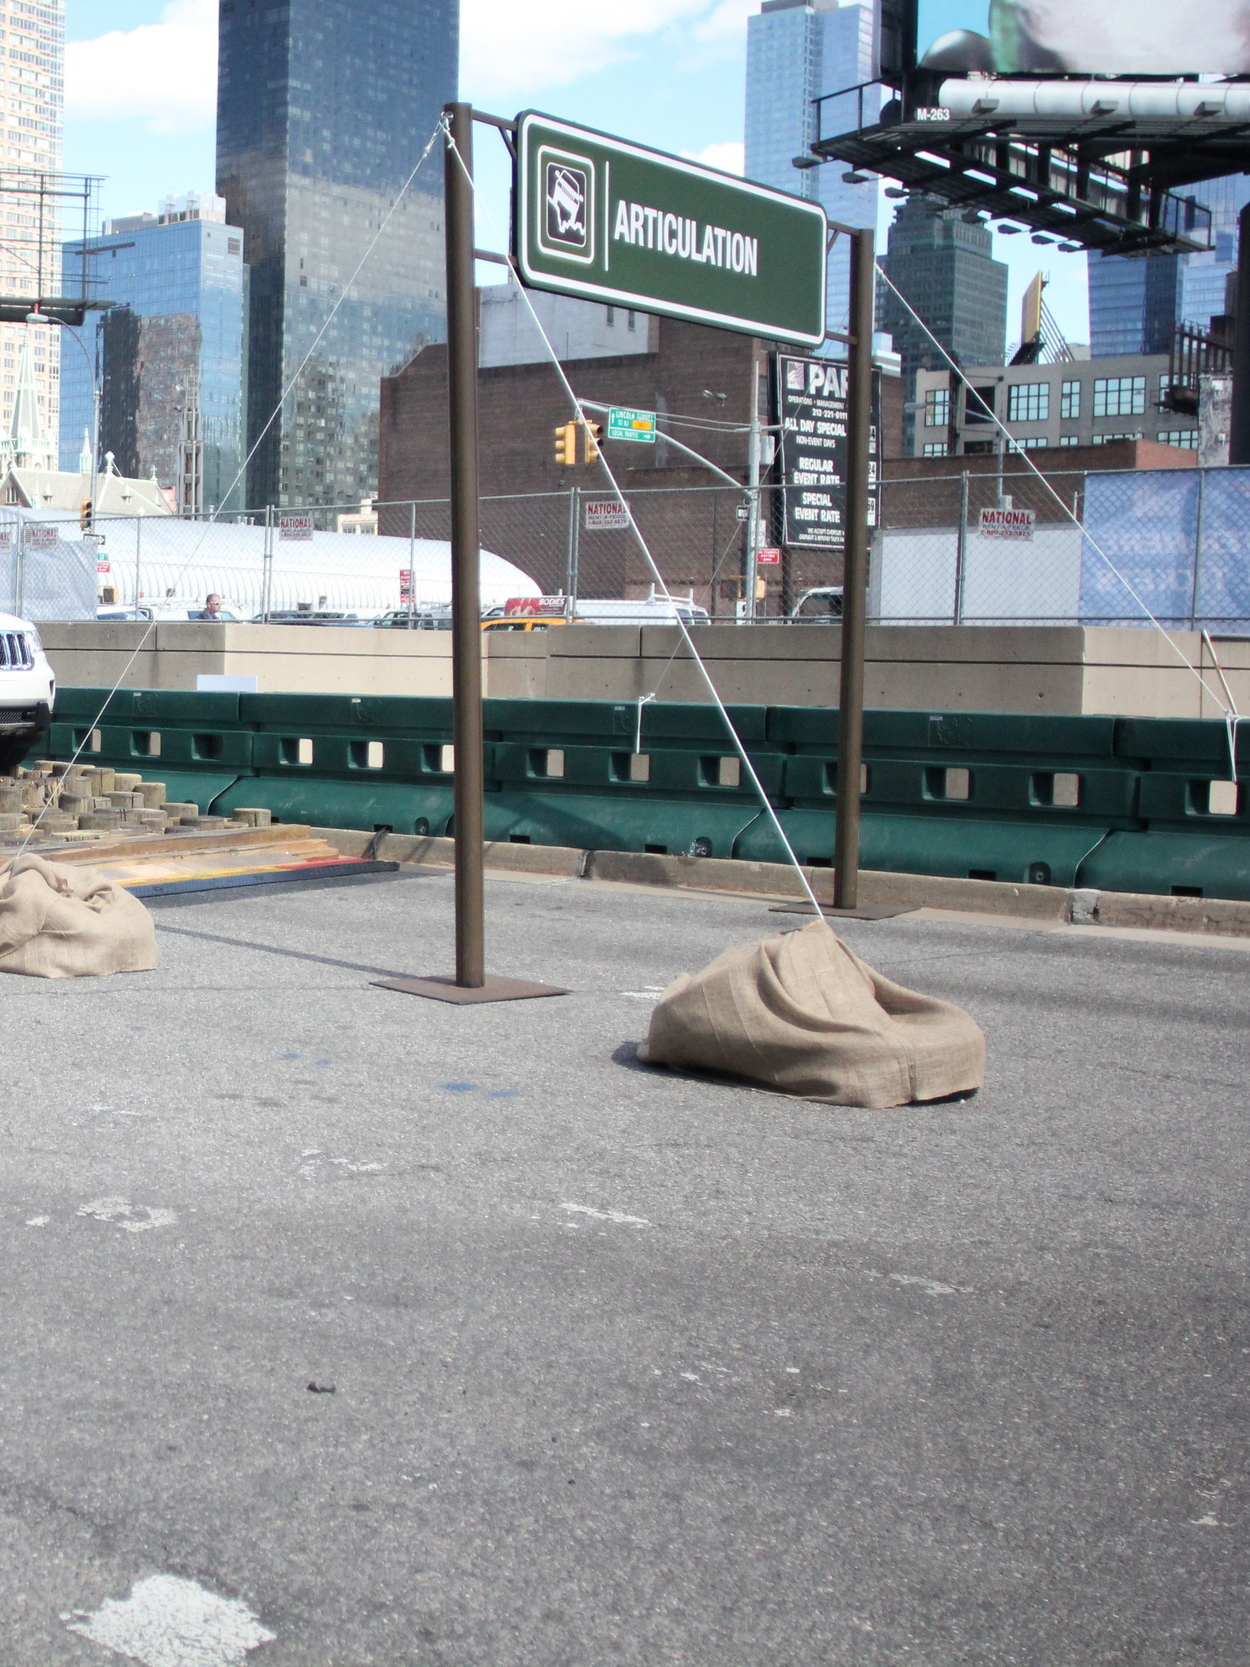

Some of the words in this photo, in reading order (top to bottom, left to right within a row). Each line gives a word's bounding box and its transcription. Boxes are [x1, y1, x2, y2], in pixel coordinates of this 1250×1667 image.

[917, 108, 950, 120] M-263
[614, 200, 758, 276] ARTICULATION
[615, 410, 635, 420] LINCOLN
[785, 417, 799, 430] ALL
[800, 419, 815, 433] DAY
[817, 421, 847, 437] SPECIAL
[823, 439, 836, 448] DAYS
[799, 457, 834, 473] REGULAR
[794, 472, 818, 485] EVENT
[819, 474, 840, 485] RATE
[802, 492, 832, 506] SPECIAL
[587, 503, 627, 514] NATIONAL
[795, 507, 818, 521] EVENT
[820, 509, 841, 523] RATE
[281, 518, 312, 528] NATIONAL
[982, 512, 1032, 525] NATIONAL
